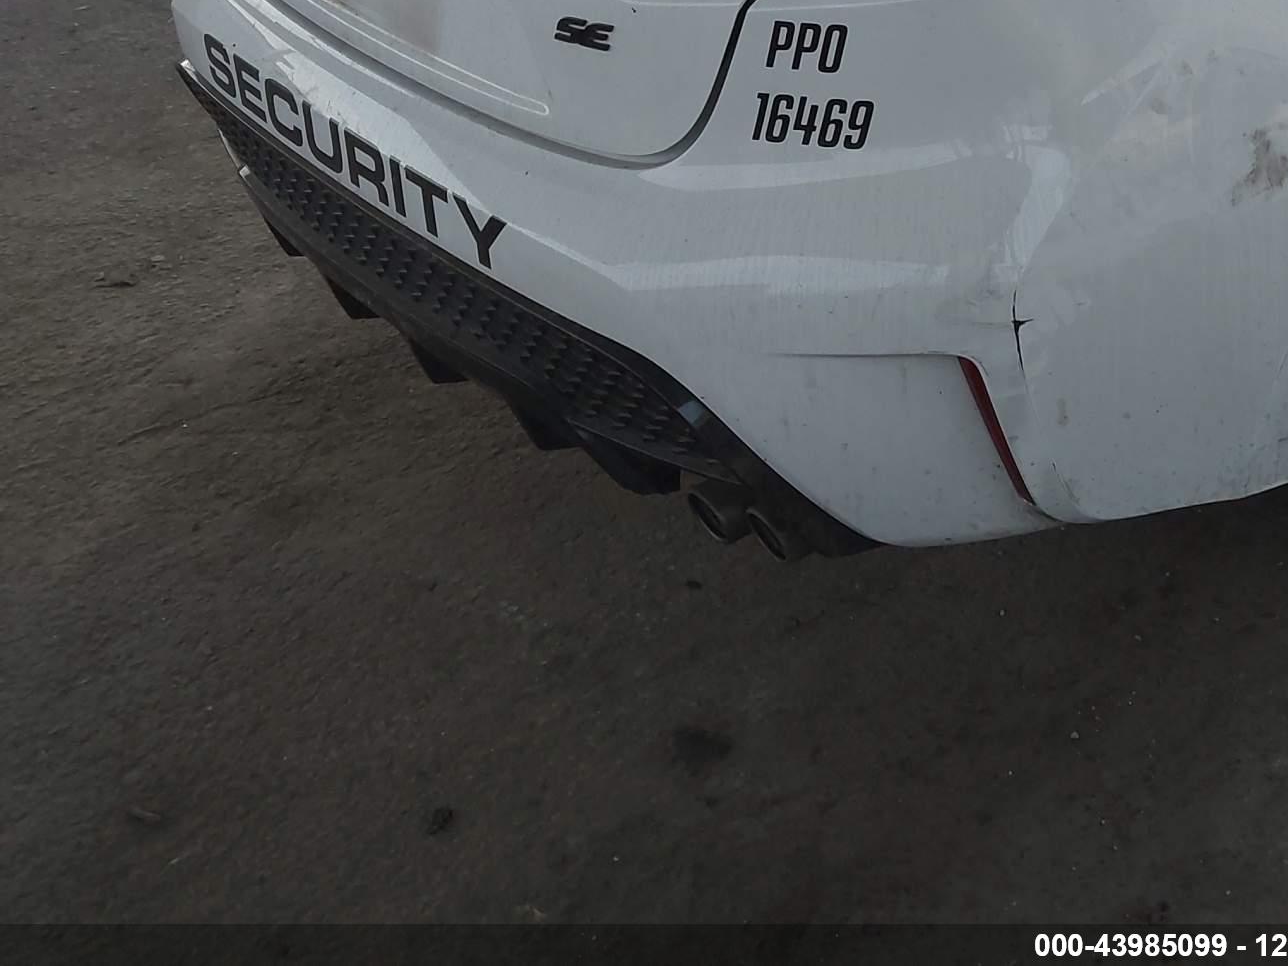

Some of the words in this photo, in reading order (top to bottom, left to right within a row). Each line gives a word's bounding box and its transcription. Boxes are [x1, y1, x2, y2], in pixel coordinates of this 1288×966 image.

[554, 16, 614, 52] SE
[765, 20, 848, 74] PPO
[751, 91, 875, 150] 16469
[203, 33, 508, 270] SECURITY
